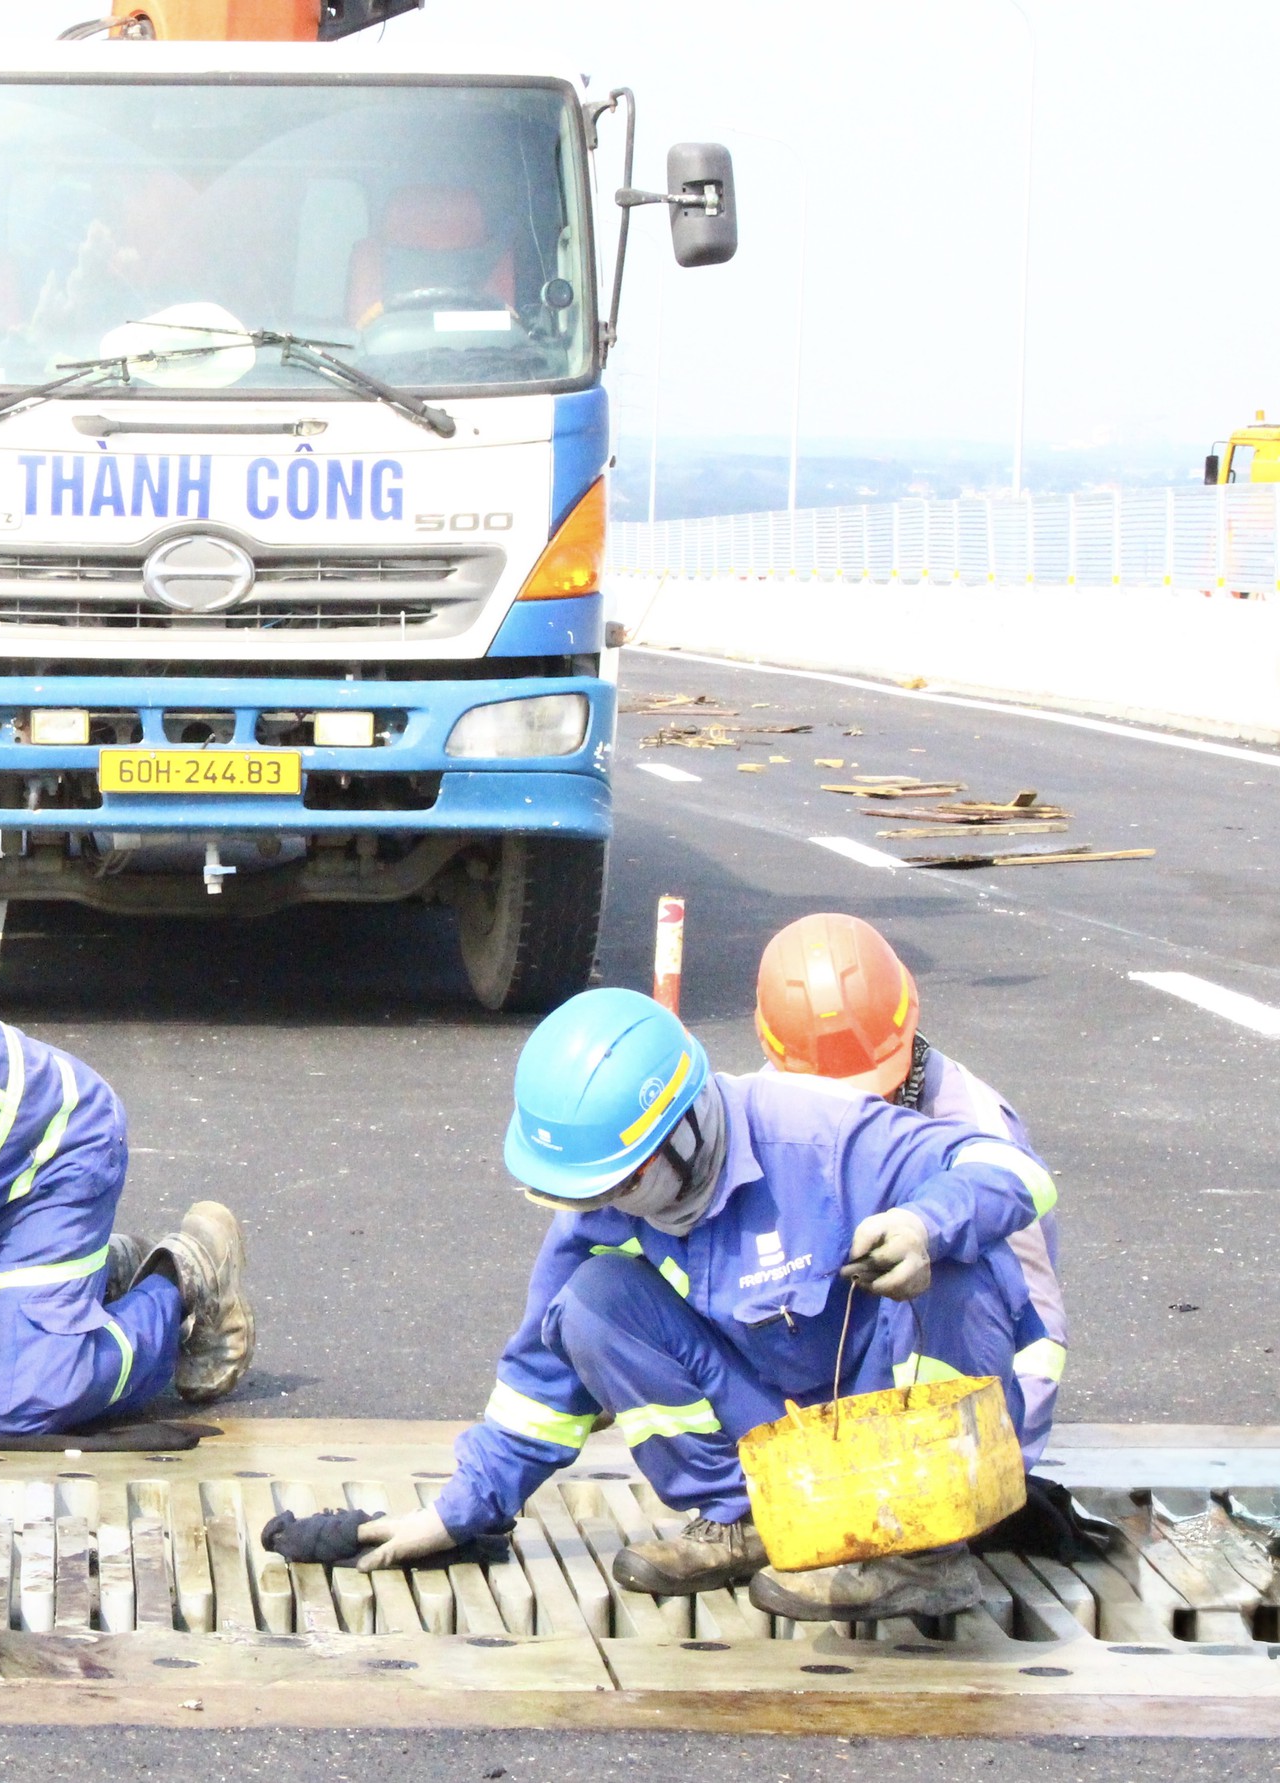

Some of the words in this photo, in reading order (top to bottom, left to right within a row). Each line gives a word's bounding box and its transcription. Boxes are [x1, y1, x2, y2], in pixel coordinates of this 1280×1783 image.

[18, 441, 212, 519] THÀNH
[246, 443, 404, 521] CÔNG
[415, 512, 513, 531] 500
[120, 760, 281, 784] 60H-244.83
